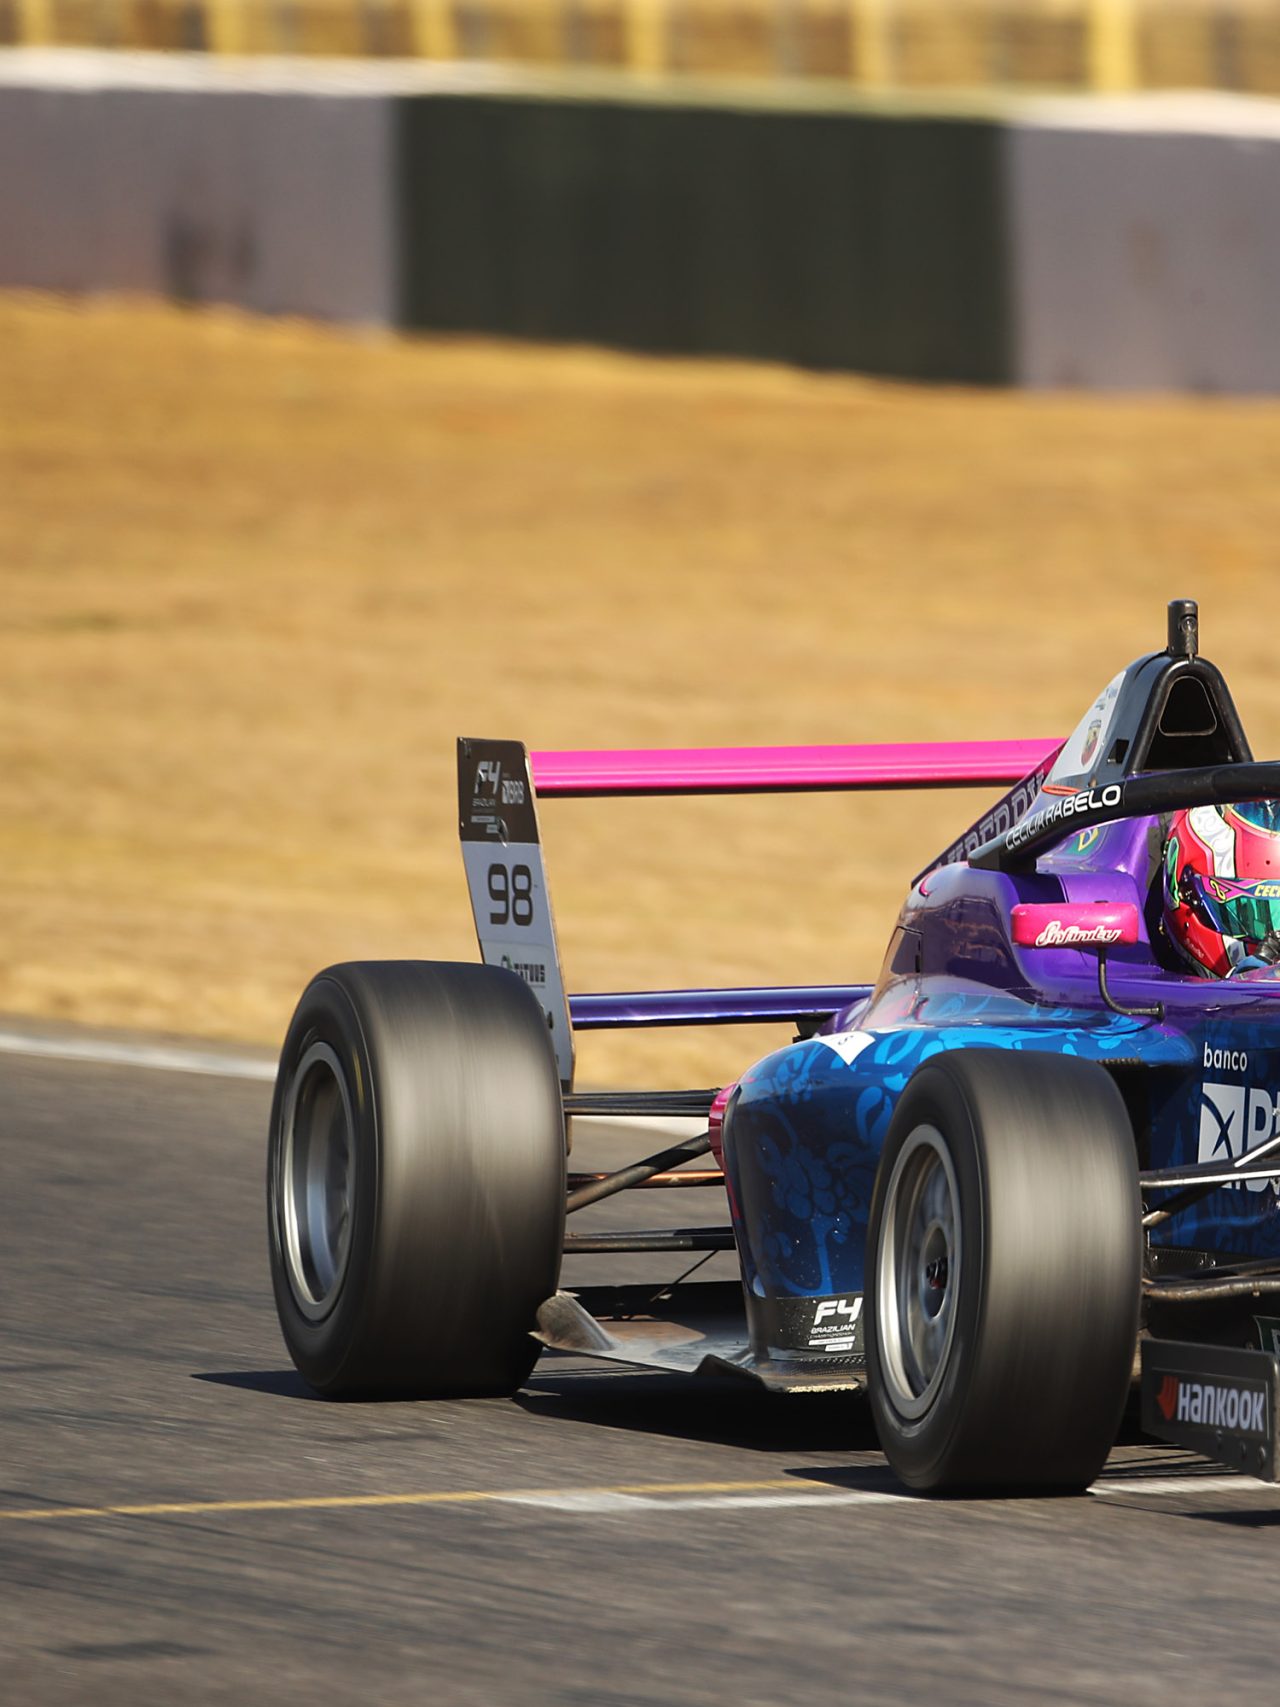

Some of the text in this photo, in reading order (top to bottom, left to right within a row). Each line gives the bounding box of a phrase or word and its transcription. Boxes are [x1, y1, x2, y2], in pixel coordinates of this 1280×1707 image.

[1005, 785, 1121, 850] CECILIA RABELO
[487, 863, 533, 926] 98
[1203, 1042, 1248, 1072] banco
[814, 1297, 864, 1326] F4
[811, 1323, 856, 1335] BRAZILIAN
